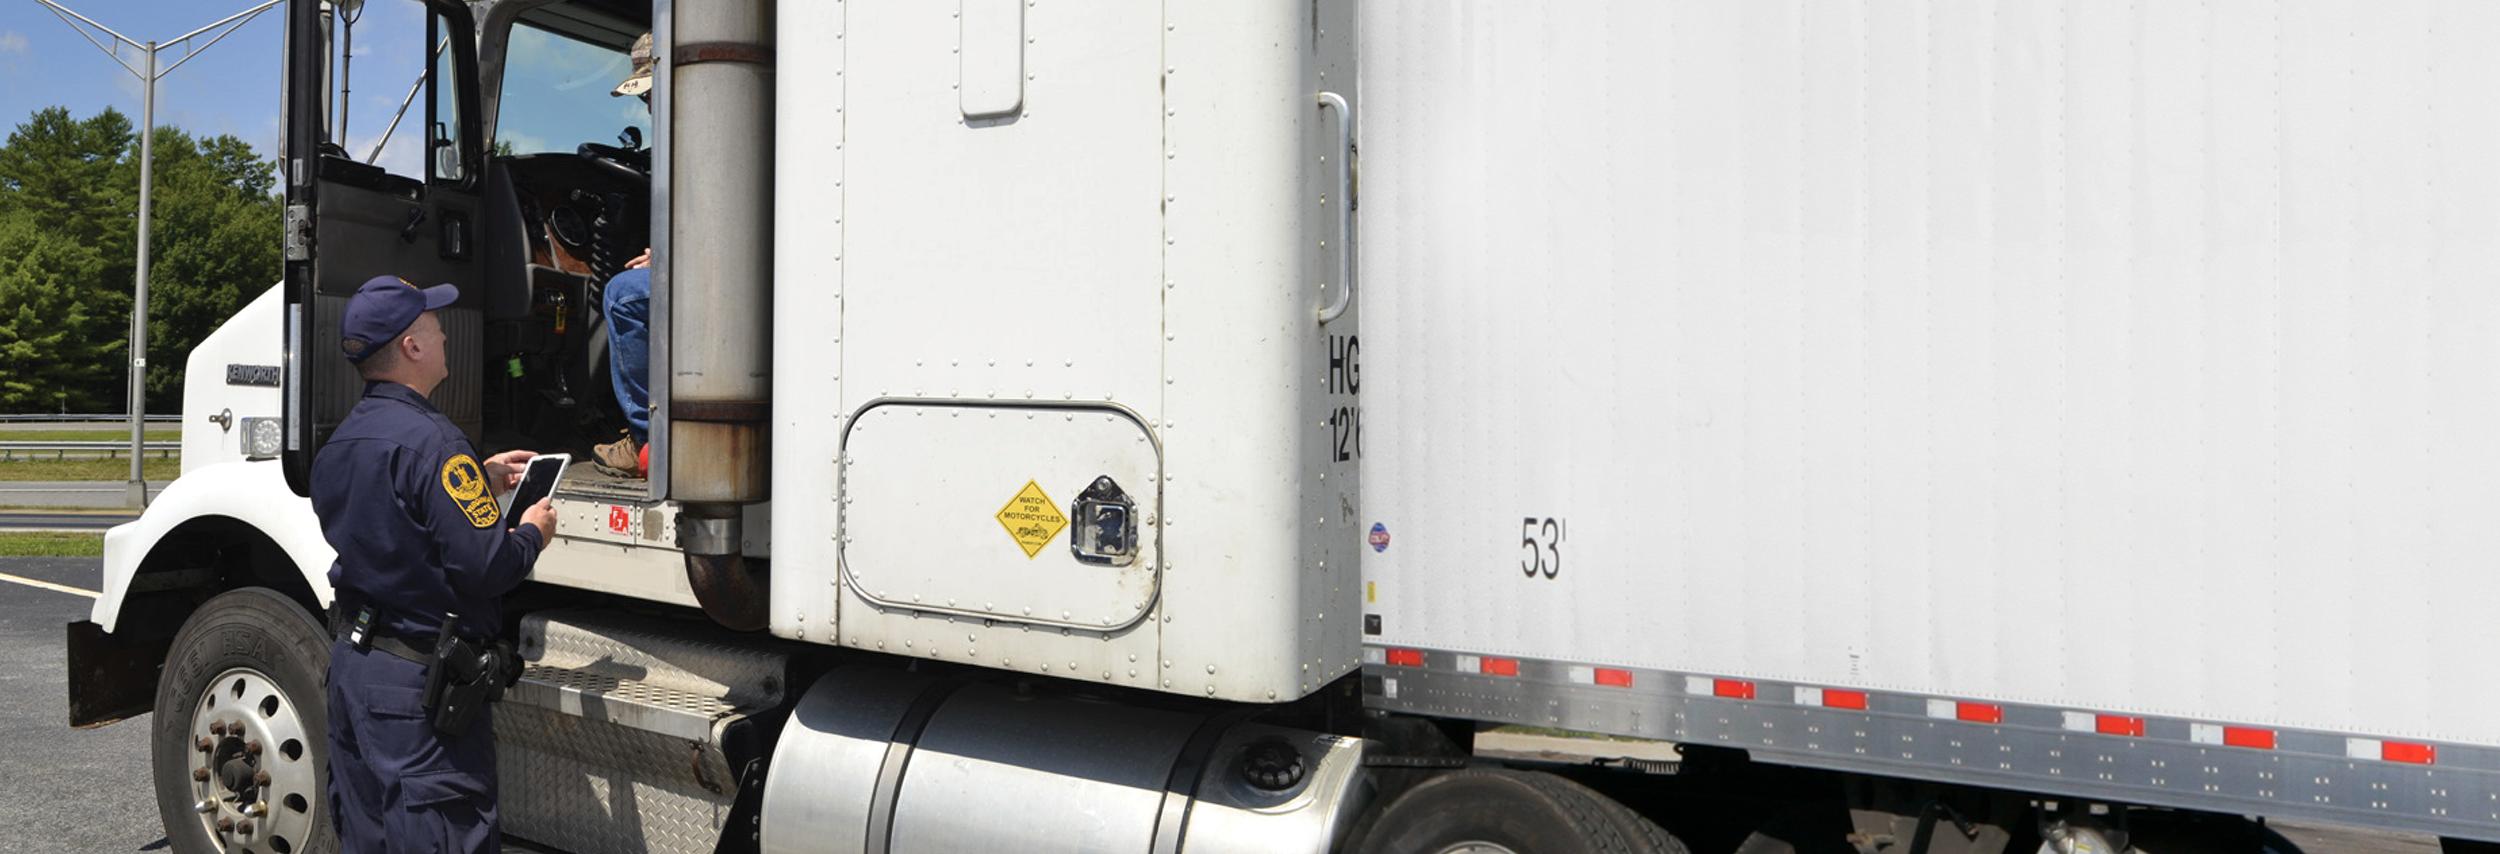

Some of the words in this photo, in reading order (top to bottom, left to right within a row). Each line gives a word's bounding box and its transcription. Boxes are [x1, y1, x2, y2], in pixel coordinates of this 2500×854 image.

[1019, 497, 1045, 505] WATCH
[472, 503, 493, 518] STATE
[1024, 505, 1040, 513] FOR
[1004, 512, 1061, 523] MOTORCYCLES
[1521, 517, 1566, 580] 53'
